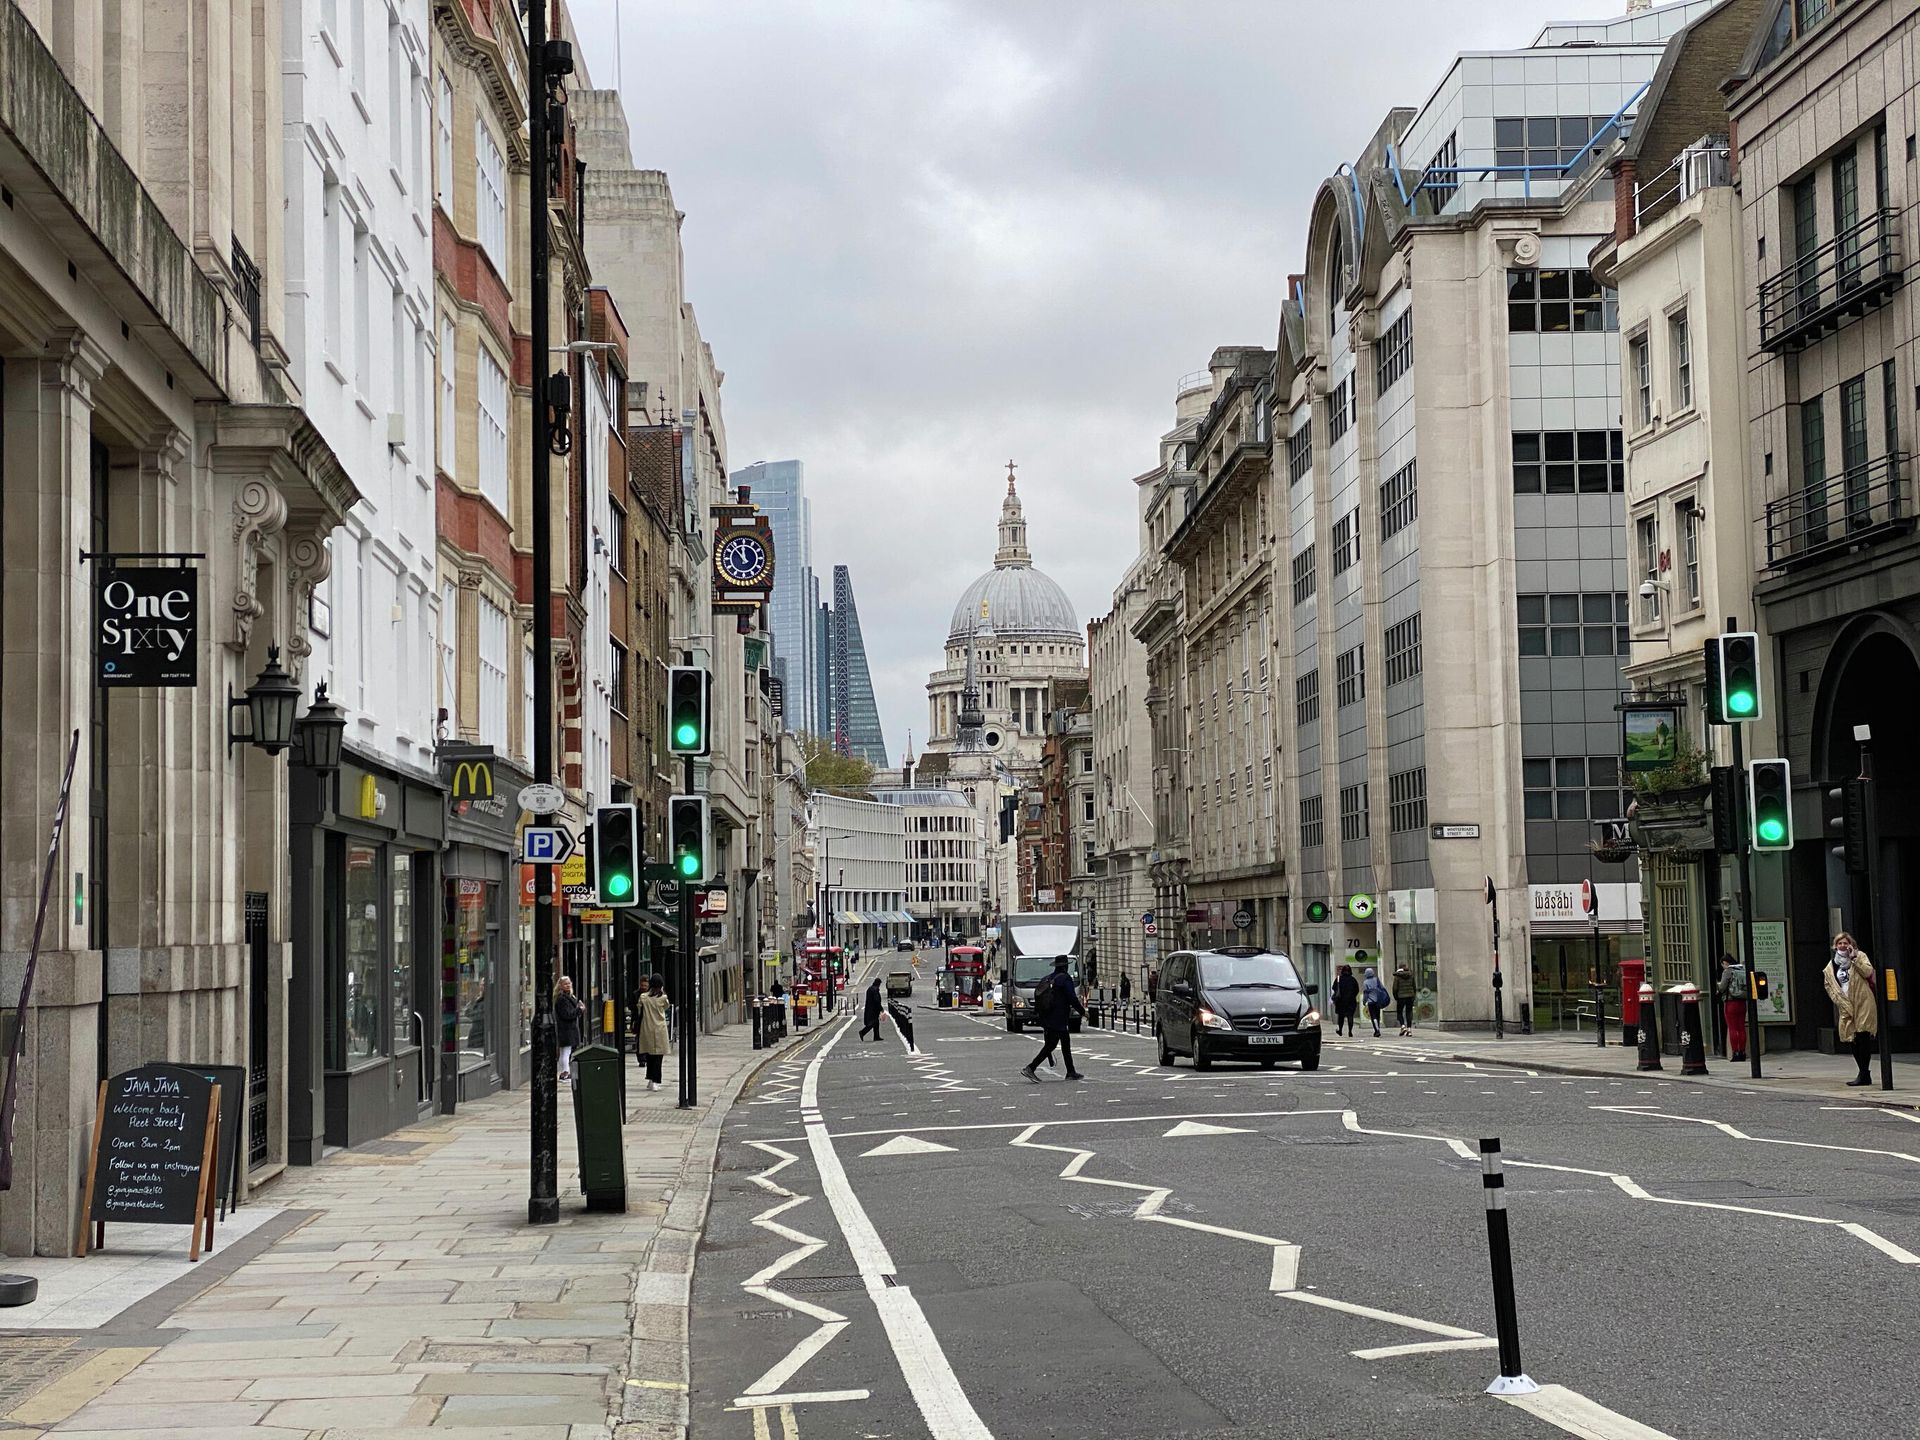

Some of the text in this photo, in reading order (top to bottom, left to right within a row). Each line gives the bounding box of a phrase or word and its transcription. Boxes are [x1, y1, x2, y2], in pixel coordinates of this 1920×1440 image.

[104, 581, 190, 621] One
[103, 613, 192, 661] Sixty
[533, 835, 551, 856] P
[1535, 892, 1573, 909] wasabi
[1347, 939, 1360, 948] 70
[124, 1077, 180, 1093] JAVA JAVA
[113, 1102, 180, 1114] Welcome back
[129, 1115, 149, 1128] Fleet
[111, 1137, 135, 1149] Open
[109, 1157, 134, 1170] Follow
[119, 1171, 129, 1183] for
